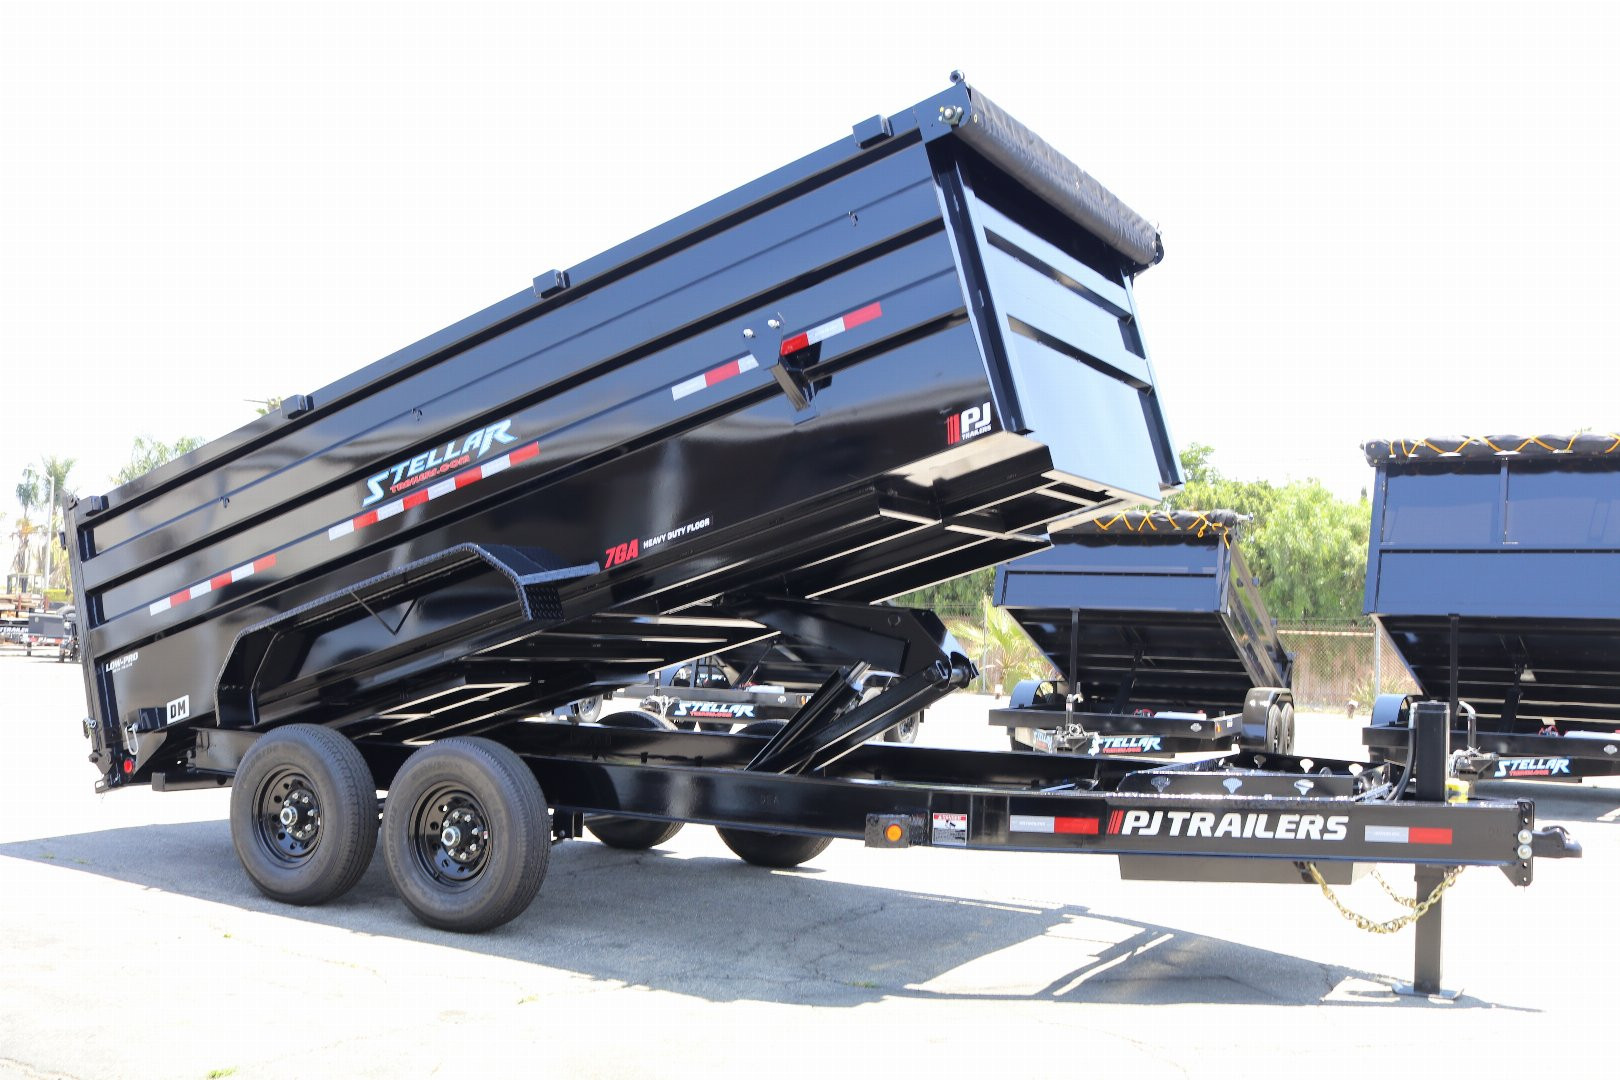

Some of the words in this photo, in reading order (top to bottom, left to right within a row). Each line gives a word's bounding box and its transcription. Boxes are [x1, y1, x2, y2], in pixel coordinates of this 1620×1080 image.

[960, 402, 991, 434] PJ
[962, 424, 992, 440] TRAILERS
[362, 419, 518, 507] STELLAR
[643, 533, 667, 549] HEAVY
[667, 526, 686, 541] DUTY
[687, 517, 710, 534] FLOOR
[105, 652, 139, 672] LOW-PRO
[170, 699, 186, 719] DM
[673, 702, 755, 718] STELLAR
[1494, 758, 1570, 778] STELLAR
[1121, 810, 1163, 836] PJ
[1167, 811, 1349, 841] TRAILERS
